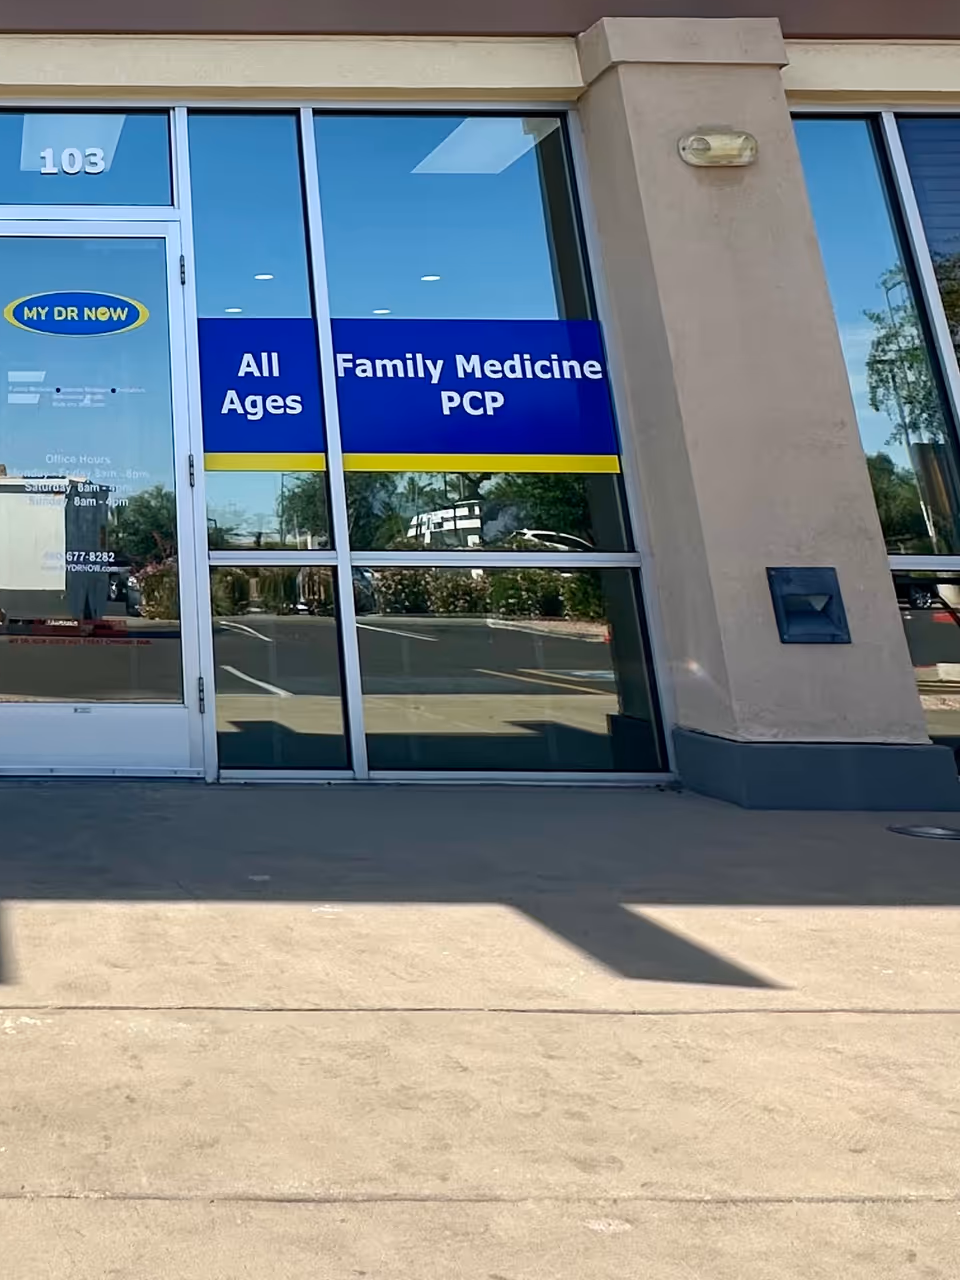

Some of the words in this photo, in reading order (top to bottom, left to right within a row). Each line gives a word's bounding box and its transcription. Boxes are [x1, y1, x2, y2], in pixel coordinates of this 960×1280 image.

[40, 147, 105, 174] 103
[24, 306, 49, 320] MY
[54, 306, 79, 321] DR
[84, 306, 128, 321] NOW
[237, 352, 280, 377] All
[336, 353, 444, 385] Family
[456, 353, 603, 380] Medicine
[220, 389, 303, 421] Ages
[440, 390, 505, 416] PCP
[45, 453, 77, 464] Office
[79, 454, 111, 465] Hours
[24, 482, 72, 494] Saturday
[77, 483, 100, 493] 8am
[73, 496, 96, 507] 8am
[105, 497, 129, 509] 4pm
